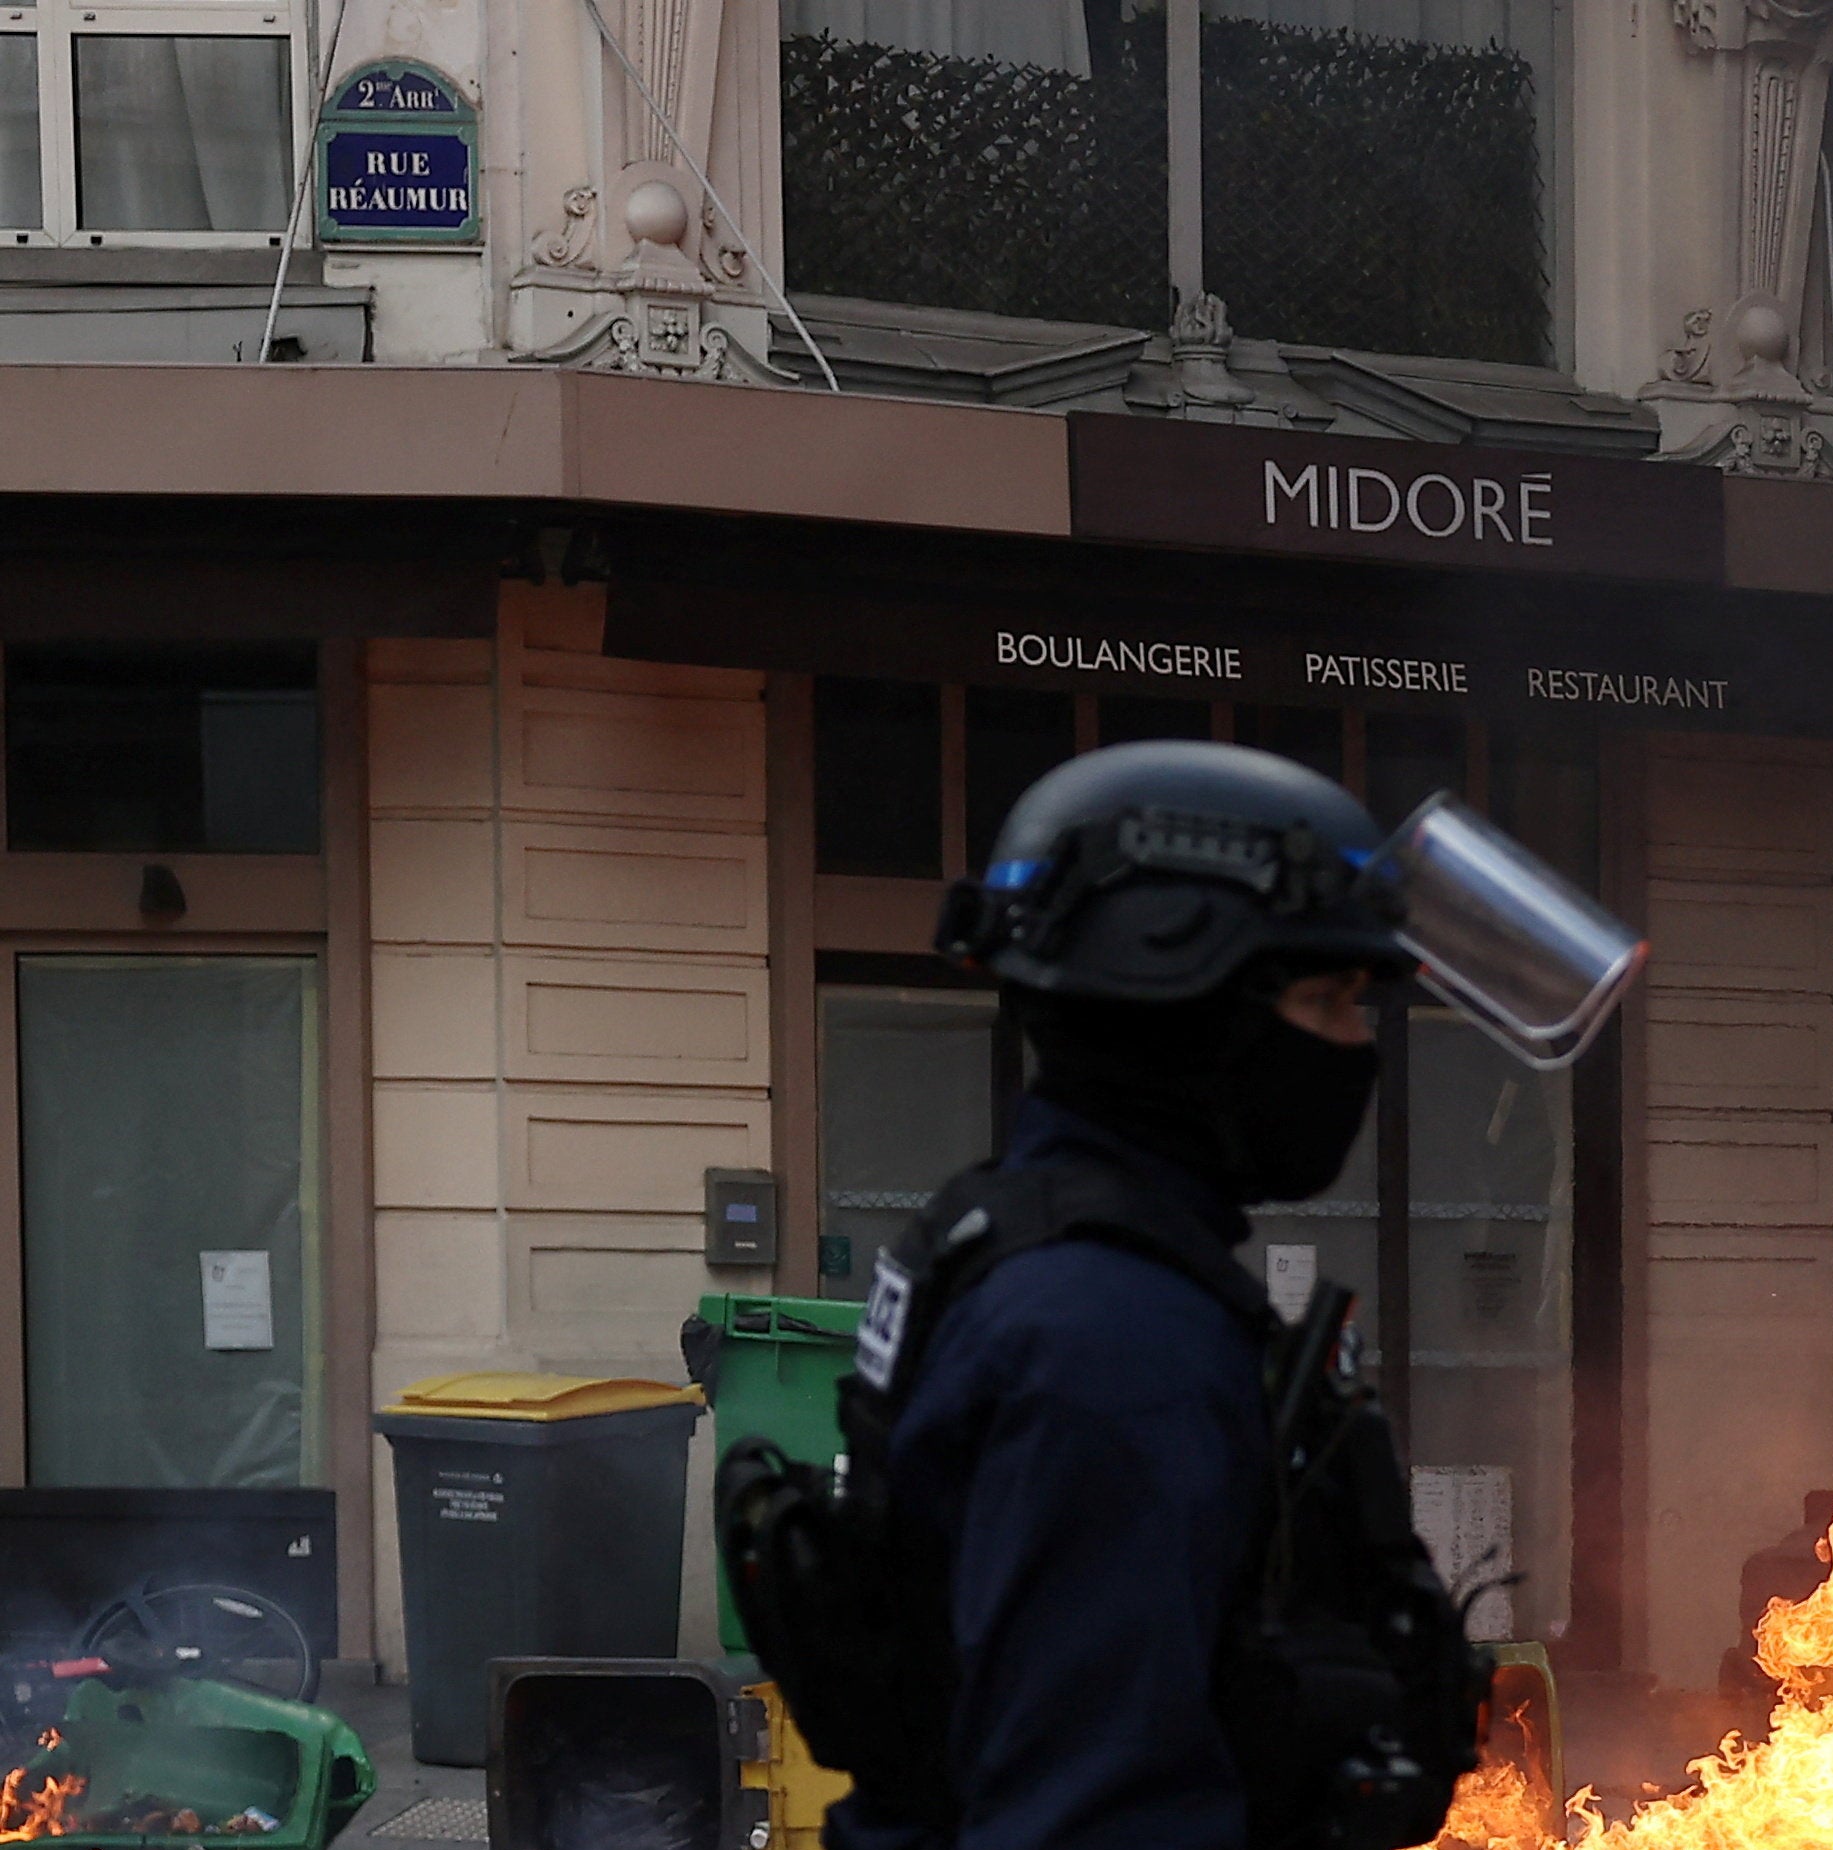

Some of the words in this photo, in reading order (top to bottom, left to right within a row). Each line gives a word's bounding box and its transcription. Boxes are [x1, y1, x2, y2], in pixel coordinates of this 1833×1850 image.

[367, 151, 430, 176] RUE
[329, 178, 468, 212] RÉAUMUR
[1263, 460, 1554, 546] MIDORÉ
[996, 632, 1242, 680] BOULANGERIE
[1304, 653, 1468, 694] PATISSERIE
[1527, 667, 1728, 710] RESTAURANT
